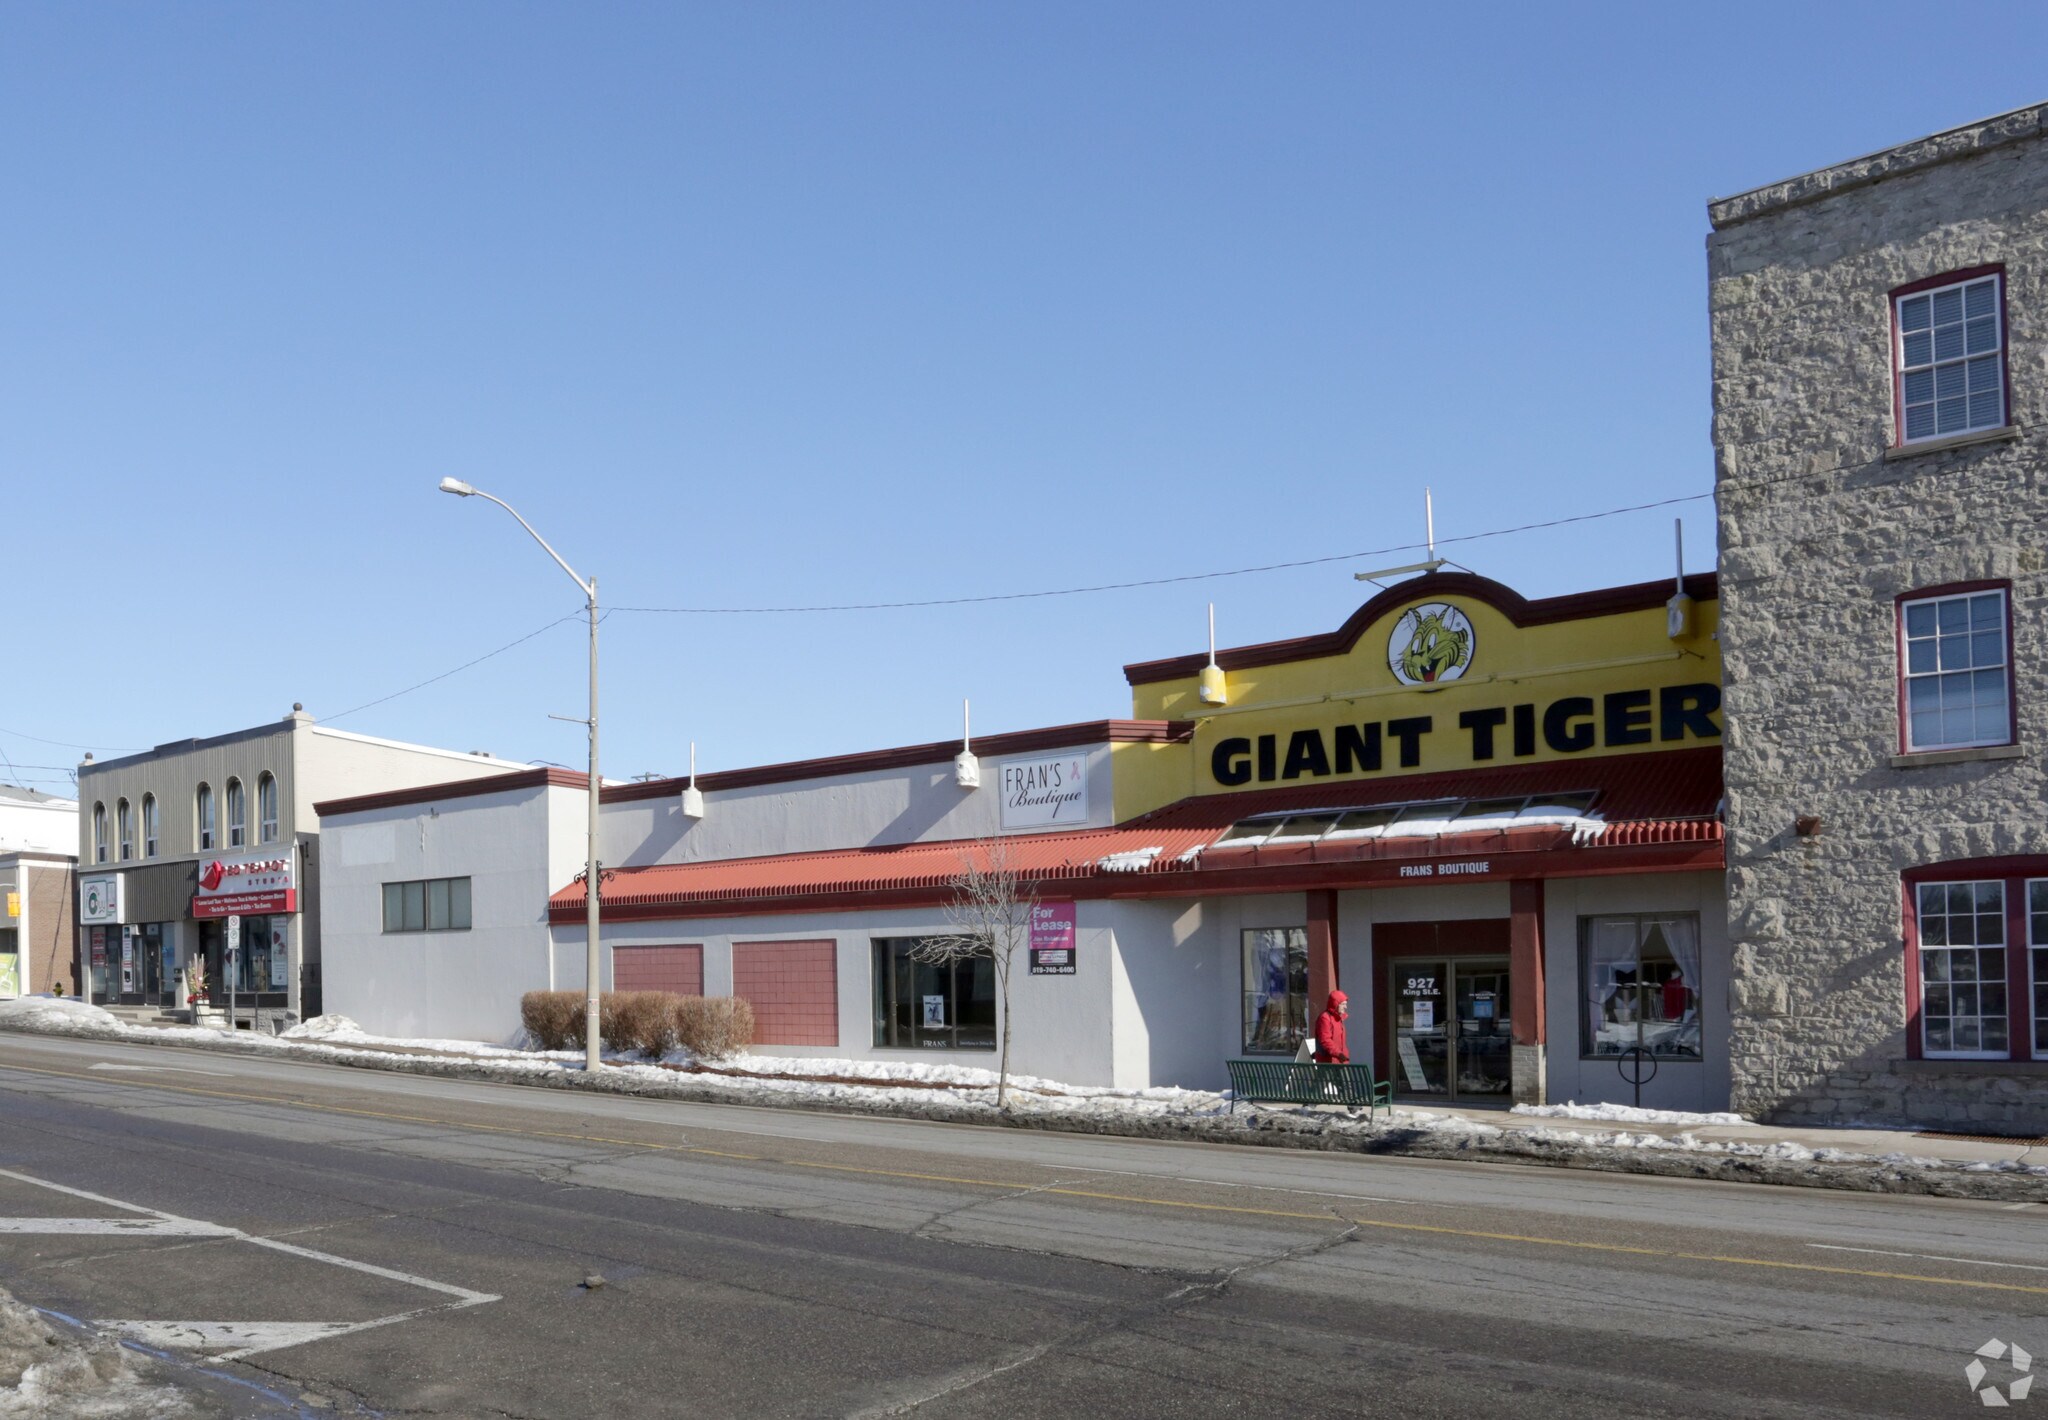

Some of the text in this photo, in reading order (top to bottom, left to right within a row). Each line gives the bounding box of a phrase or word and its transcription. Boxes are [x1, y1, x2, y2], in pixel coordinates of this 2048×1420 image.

[1211, 682, 1722, 786] GIANT TIGER
[1006, 763, 1062, 793] FRAN'S
[1009, 789, 1082, 819] Boutique
[243, 860, 286, 875] TEAPOT
[1400, 861, 1489, 877] FRANS BOUTIQUE
[1033, 907, 1054, 918] For
[1033, 919, 1072, 931] Lease
[1407, 978, 1435, 989] 927
[1403, 988, 1421, 996] King
